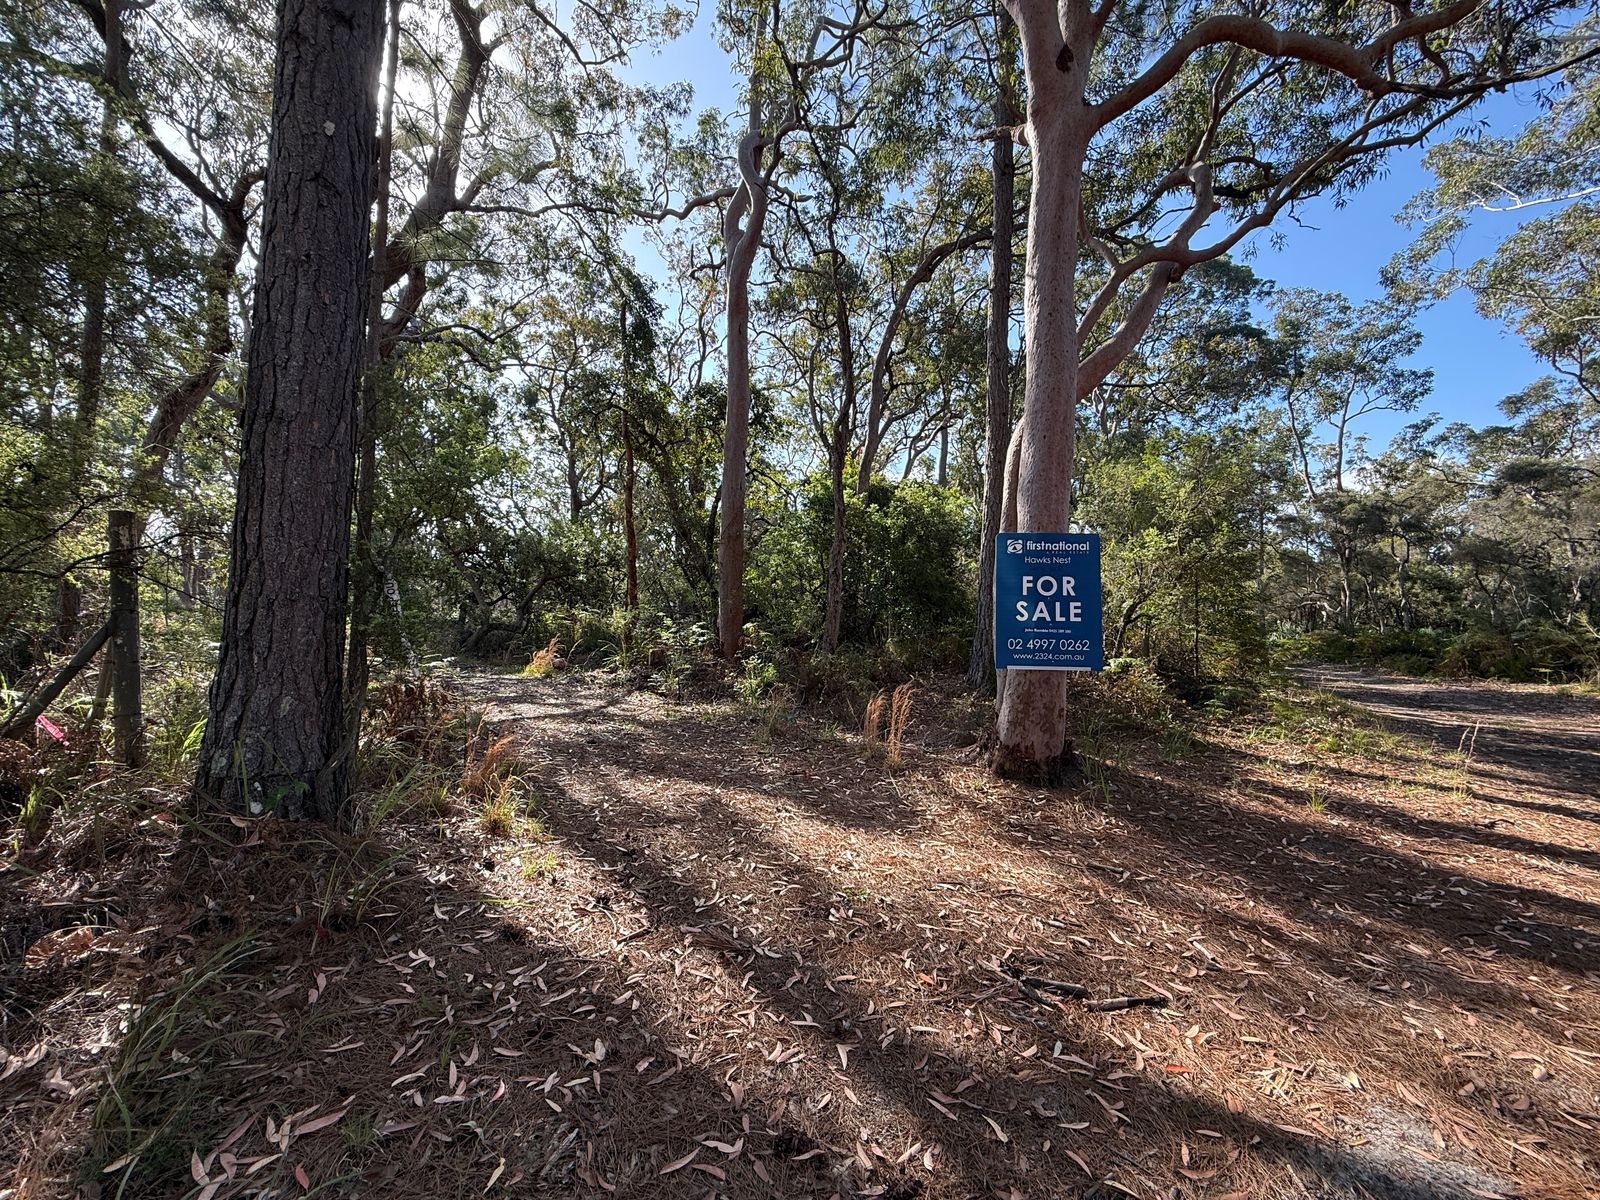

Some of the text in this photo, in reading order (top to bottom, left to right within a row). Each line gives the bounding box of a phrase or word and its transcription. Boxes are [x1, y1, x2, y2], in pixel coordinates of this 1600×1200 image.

[1026, 541, 1090, 551] firstnational
[1024, 556, 1071, 564] Hawks Nest
[1022, 575, 1076, 596] FOR
[1015, 600, 1082, 622] SALE
[1007, 638, 1090, 651] 02 4997 0262
[1012, 652, 1085, 661] www.2324.com.au
